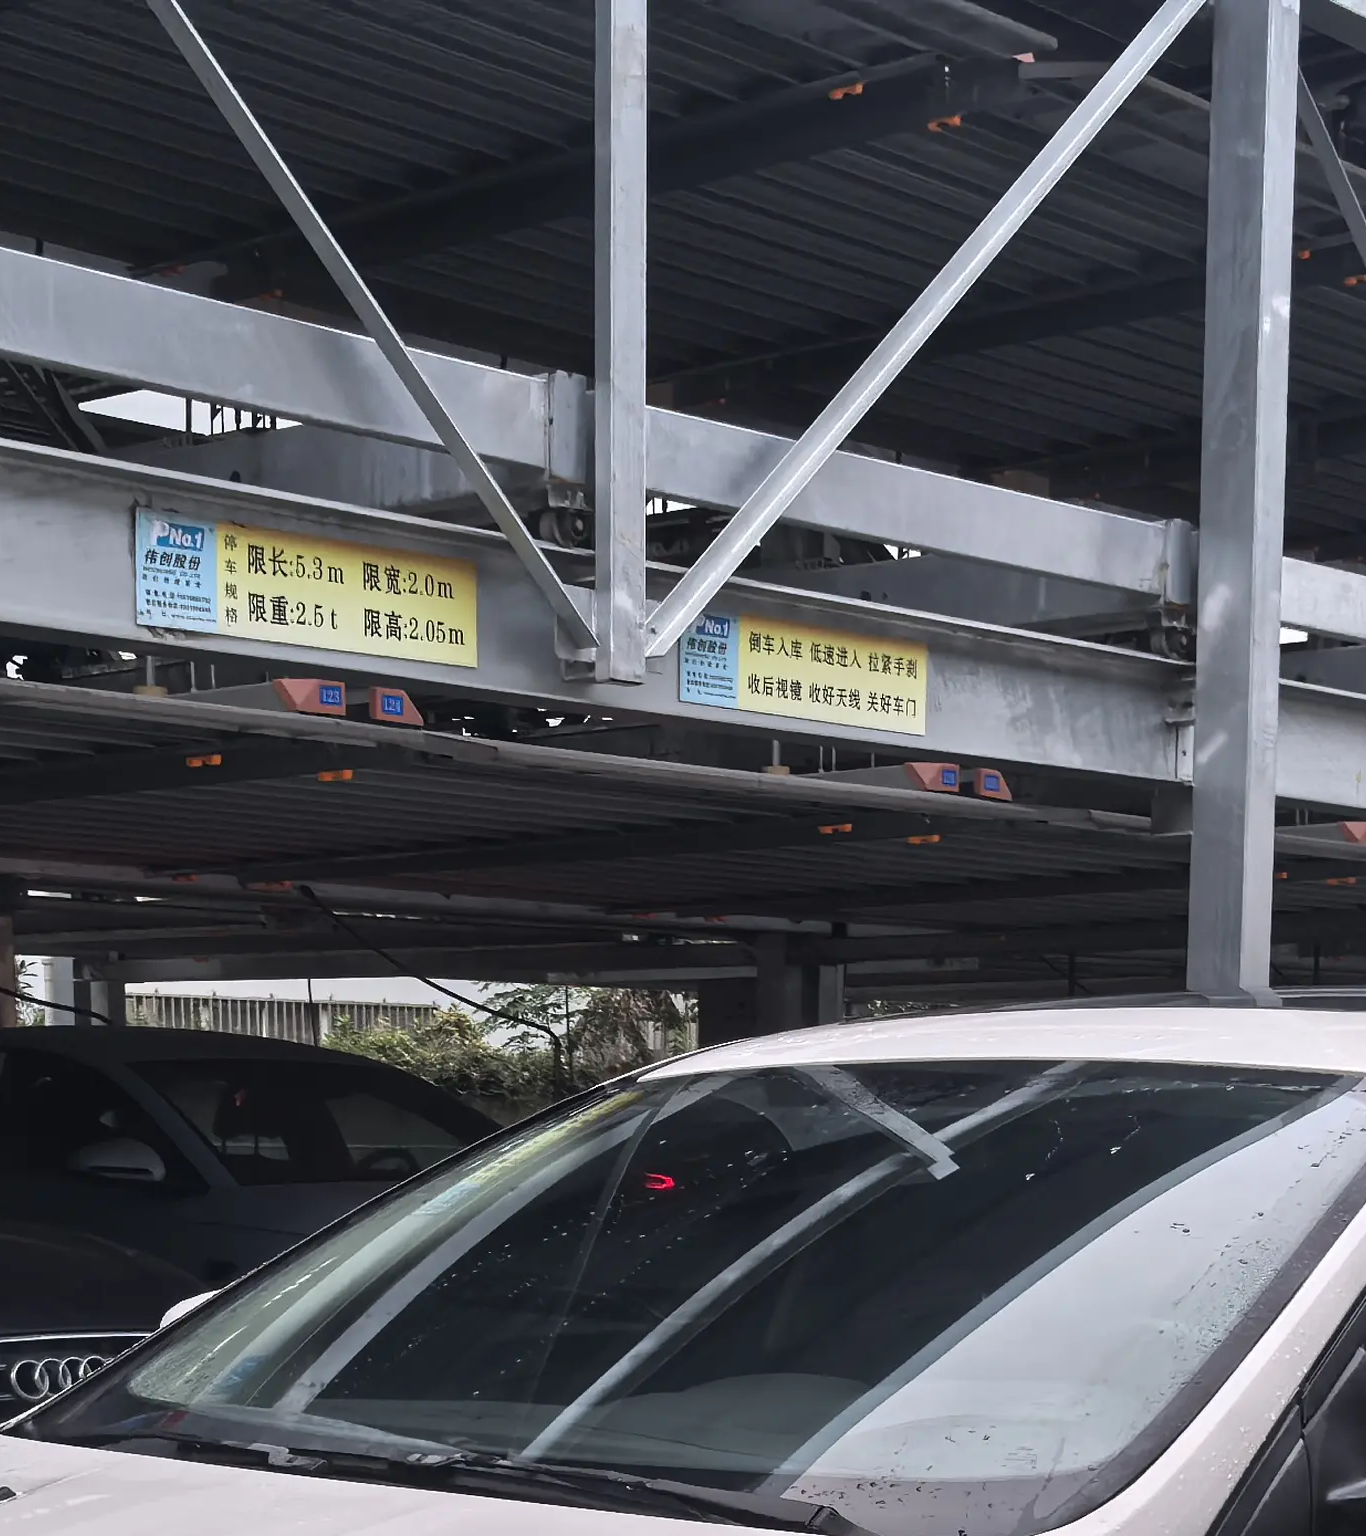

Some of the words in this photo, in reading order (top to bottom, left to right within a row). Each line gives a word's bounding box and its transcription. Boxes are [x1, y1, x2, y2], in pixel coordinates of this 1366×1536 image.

[144, 547, 202, 571] 伟创股份
[748, 631, 803, 660] 倒车入库
[747, 673, 803, 701] 收后视镜
[808, 682, 861, 711] 收好天线
[866, 691, 917, 719] 关好车门
